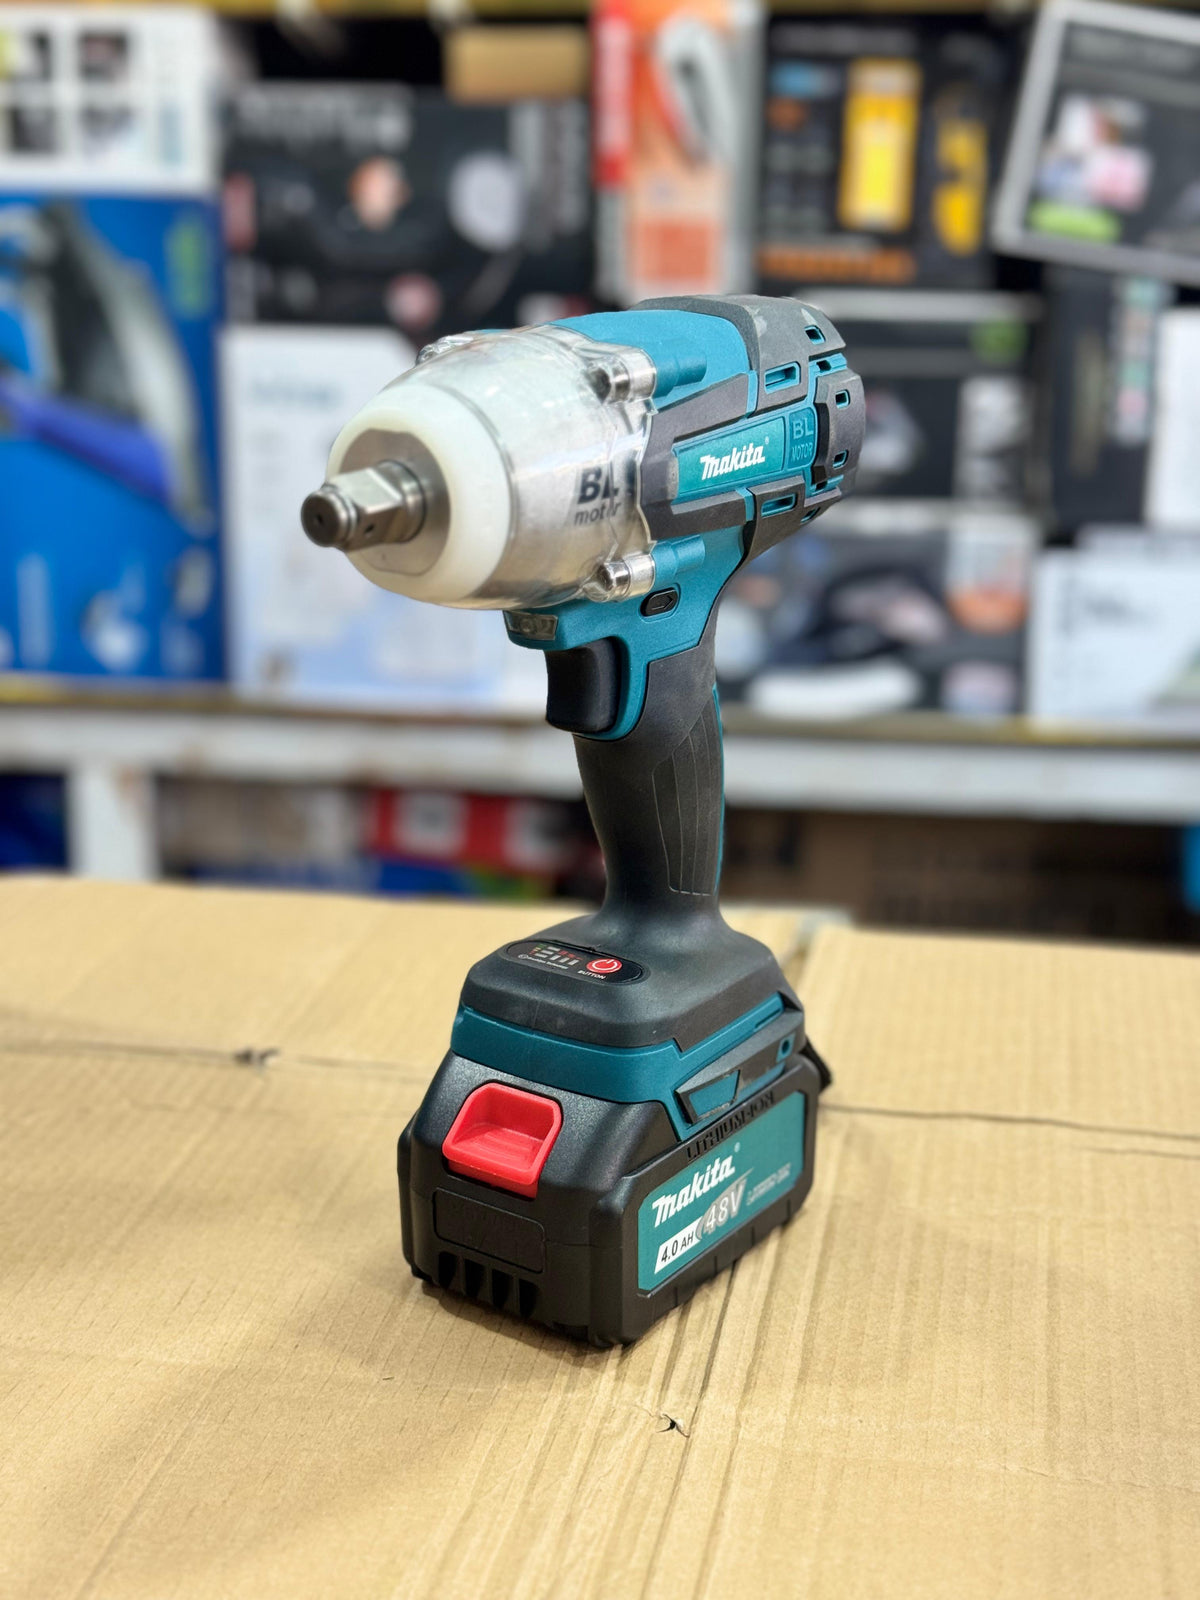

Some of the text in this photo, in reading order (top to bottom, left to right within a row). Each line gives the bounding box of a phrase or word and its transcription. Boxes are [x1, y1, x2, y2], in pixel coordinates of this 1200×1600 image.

[793, 417, 814, 440] BL
[791, 442, 813, 461] MOTOR
[577, 466, 619, 504] BL
[577, 970, 607, 980] BUTTON
[660, 1240, 679, 1263] 4.0
[680, 1230, 695, 1251] AH
[703, 1178, 747, 1235] 48V
